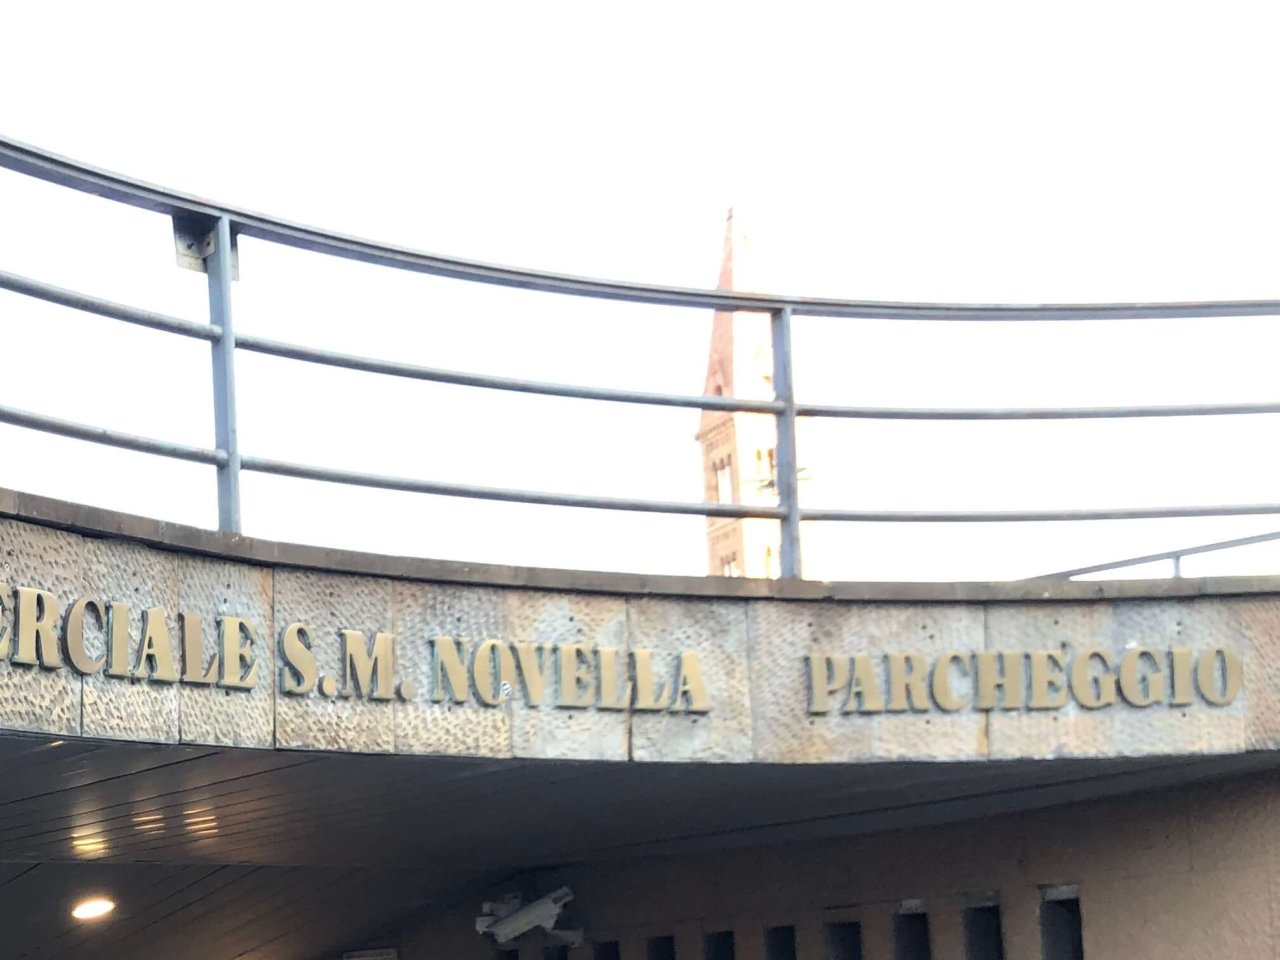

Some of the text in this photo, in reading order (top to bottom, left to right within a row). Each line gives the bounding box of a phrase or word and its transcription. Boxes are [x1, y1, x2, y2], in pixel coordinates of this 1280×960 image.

[280, 622, 415, 702] S.M.
[430, 634, 710, 714] NOVELLA
[805, 647, 1243, 715] PARCHEGGIO
